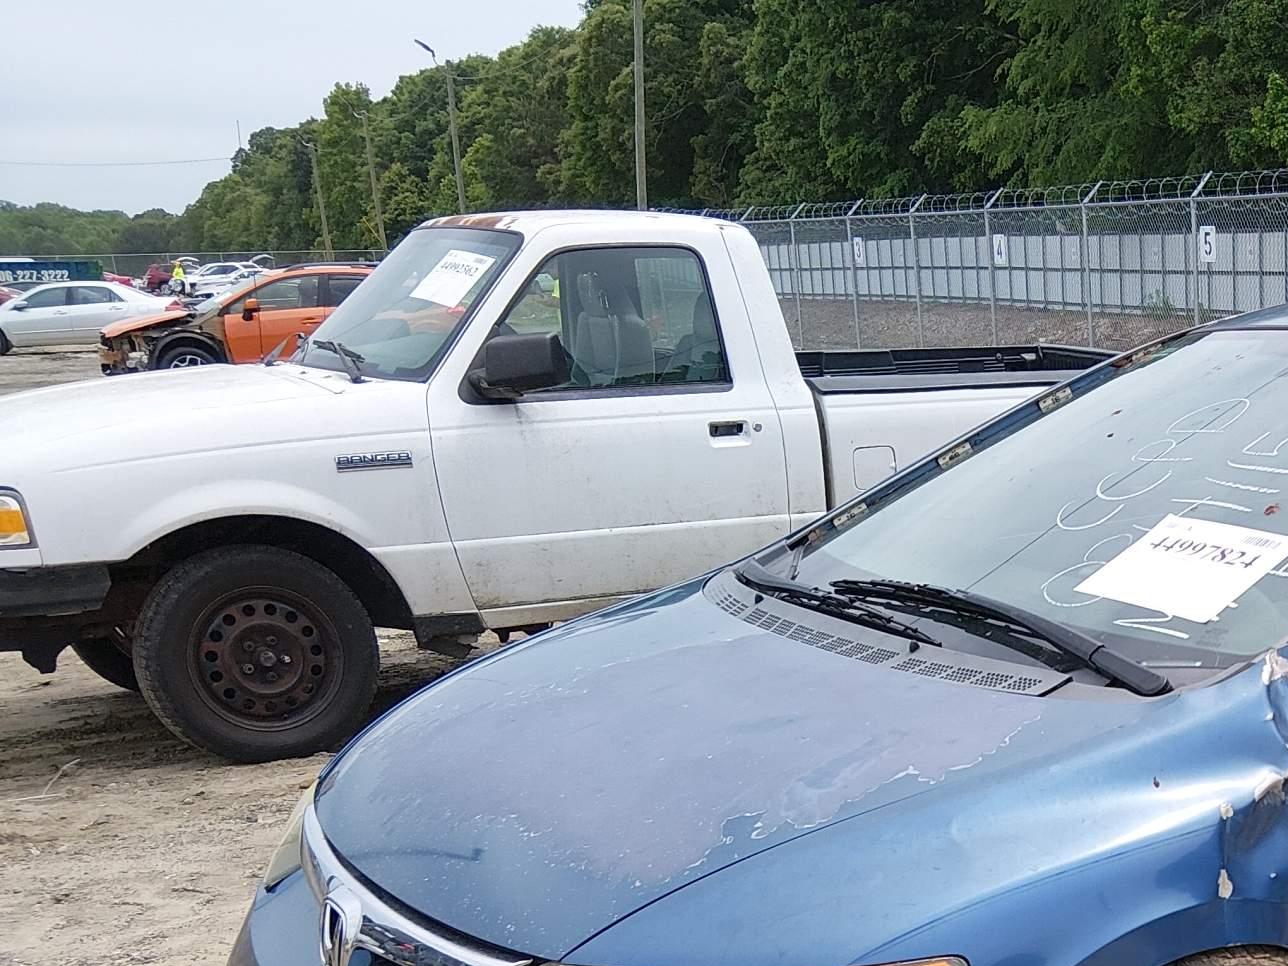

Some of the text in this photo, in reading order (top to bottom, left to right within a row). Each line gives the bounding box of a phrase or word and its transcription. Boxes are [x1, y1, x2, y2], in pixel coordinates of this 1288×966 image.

[855, 242, 862, 258] 3
[997, 240, 1004, 259] 4
[1204, 231, 1213, 256] 5
[337, 452, 412, 466] RANGER
[1150, 535, 1262, 569] 44997824
